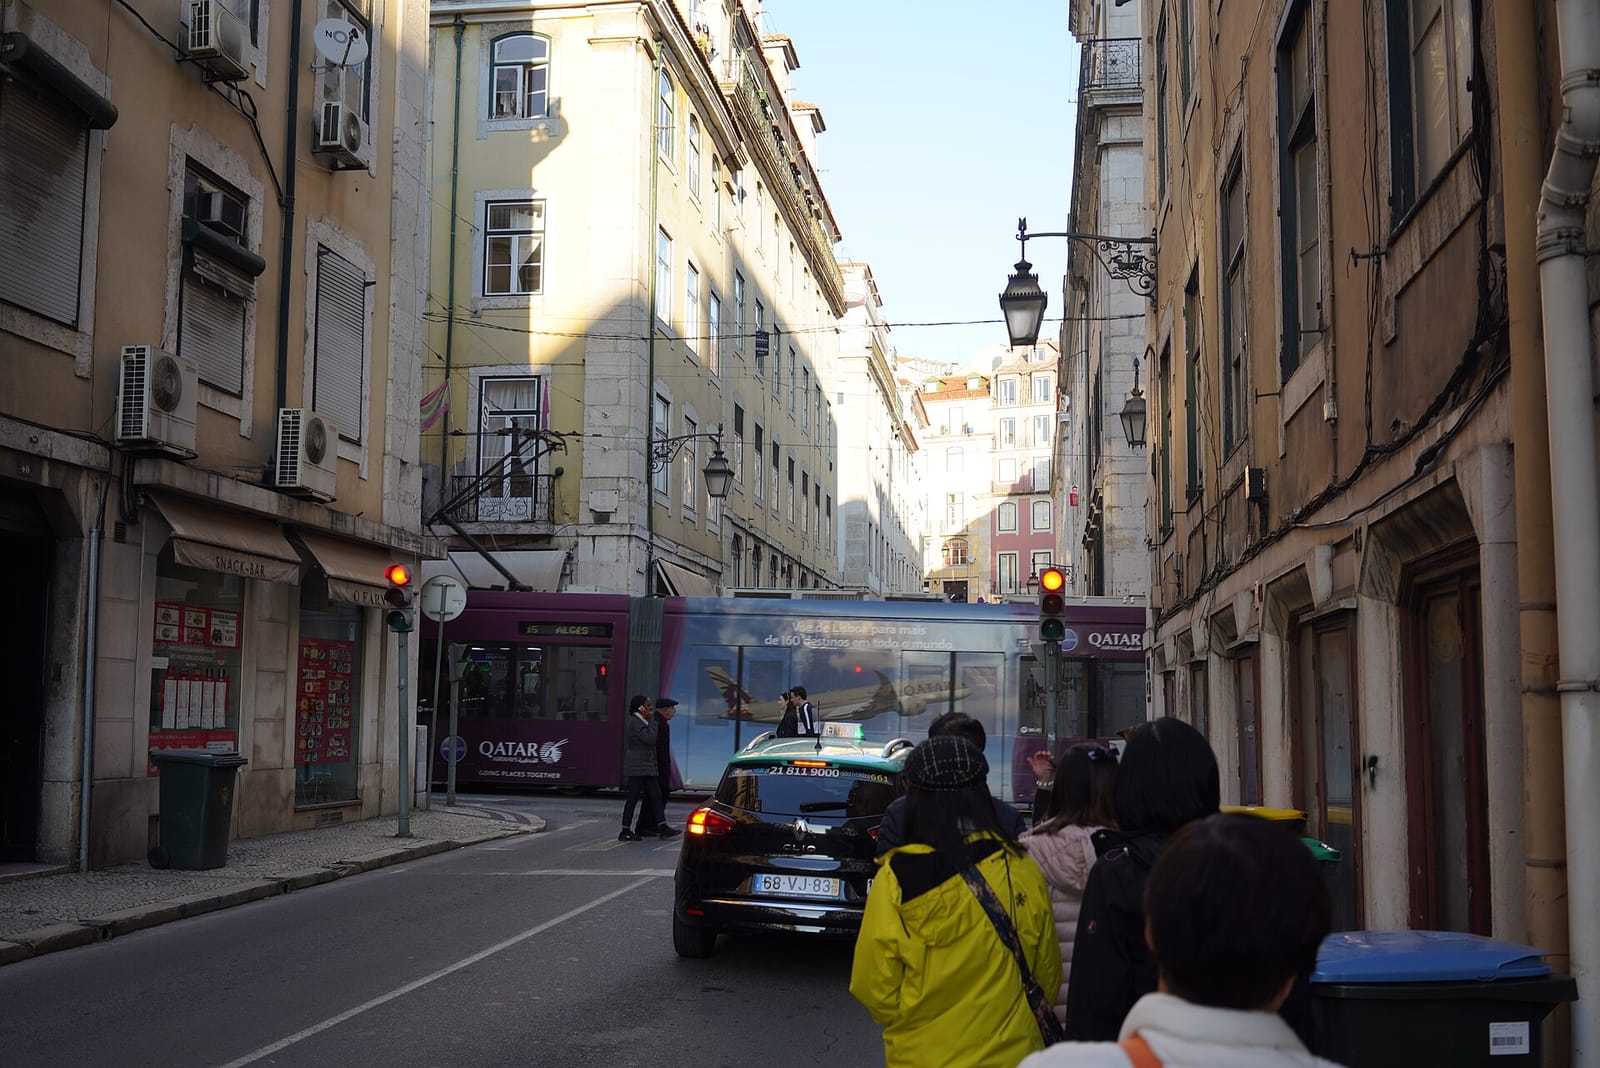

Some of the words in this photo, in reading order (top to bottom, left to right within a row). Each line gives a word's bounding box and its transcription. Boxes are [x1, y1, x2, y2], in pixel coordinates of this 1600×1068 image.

[215, 555, 266, 578] SNACK-BAR
[791, 621, 813, 633] Voe
[815, 622, 828, 633] de
[831, 622, 868, 634] Lisboa
[871, 626, 897, 637] para
[899, 624, 927, 636] mais
[764, 634, 779, 646] de
[781, 635, 801, 647] 160
[802, 635, 850, 648] destinos
[852, 639, 870, 648] em
[872, 638, 900, 649] todo
[901, 640, 910, 649] o
[911, 639, 953, 650] mundo
[1088, 632, 1141, 648] QATAR
[479, 740, 539, 759] QATAR
[501, 770, 526, 778] PLACES
[526, 771, 561, 779] TOGETHER
[769, 766, 784, 775] 21
[786, 766, 808, 776] 811
[810, 767, 840, 778] 9000
[870, 773, 889, 783] 661
[782, 843, 816, 853] CLIO
